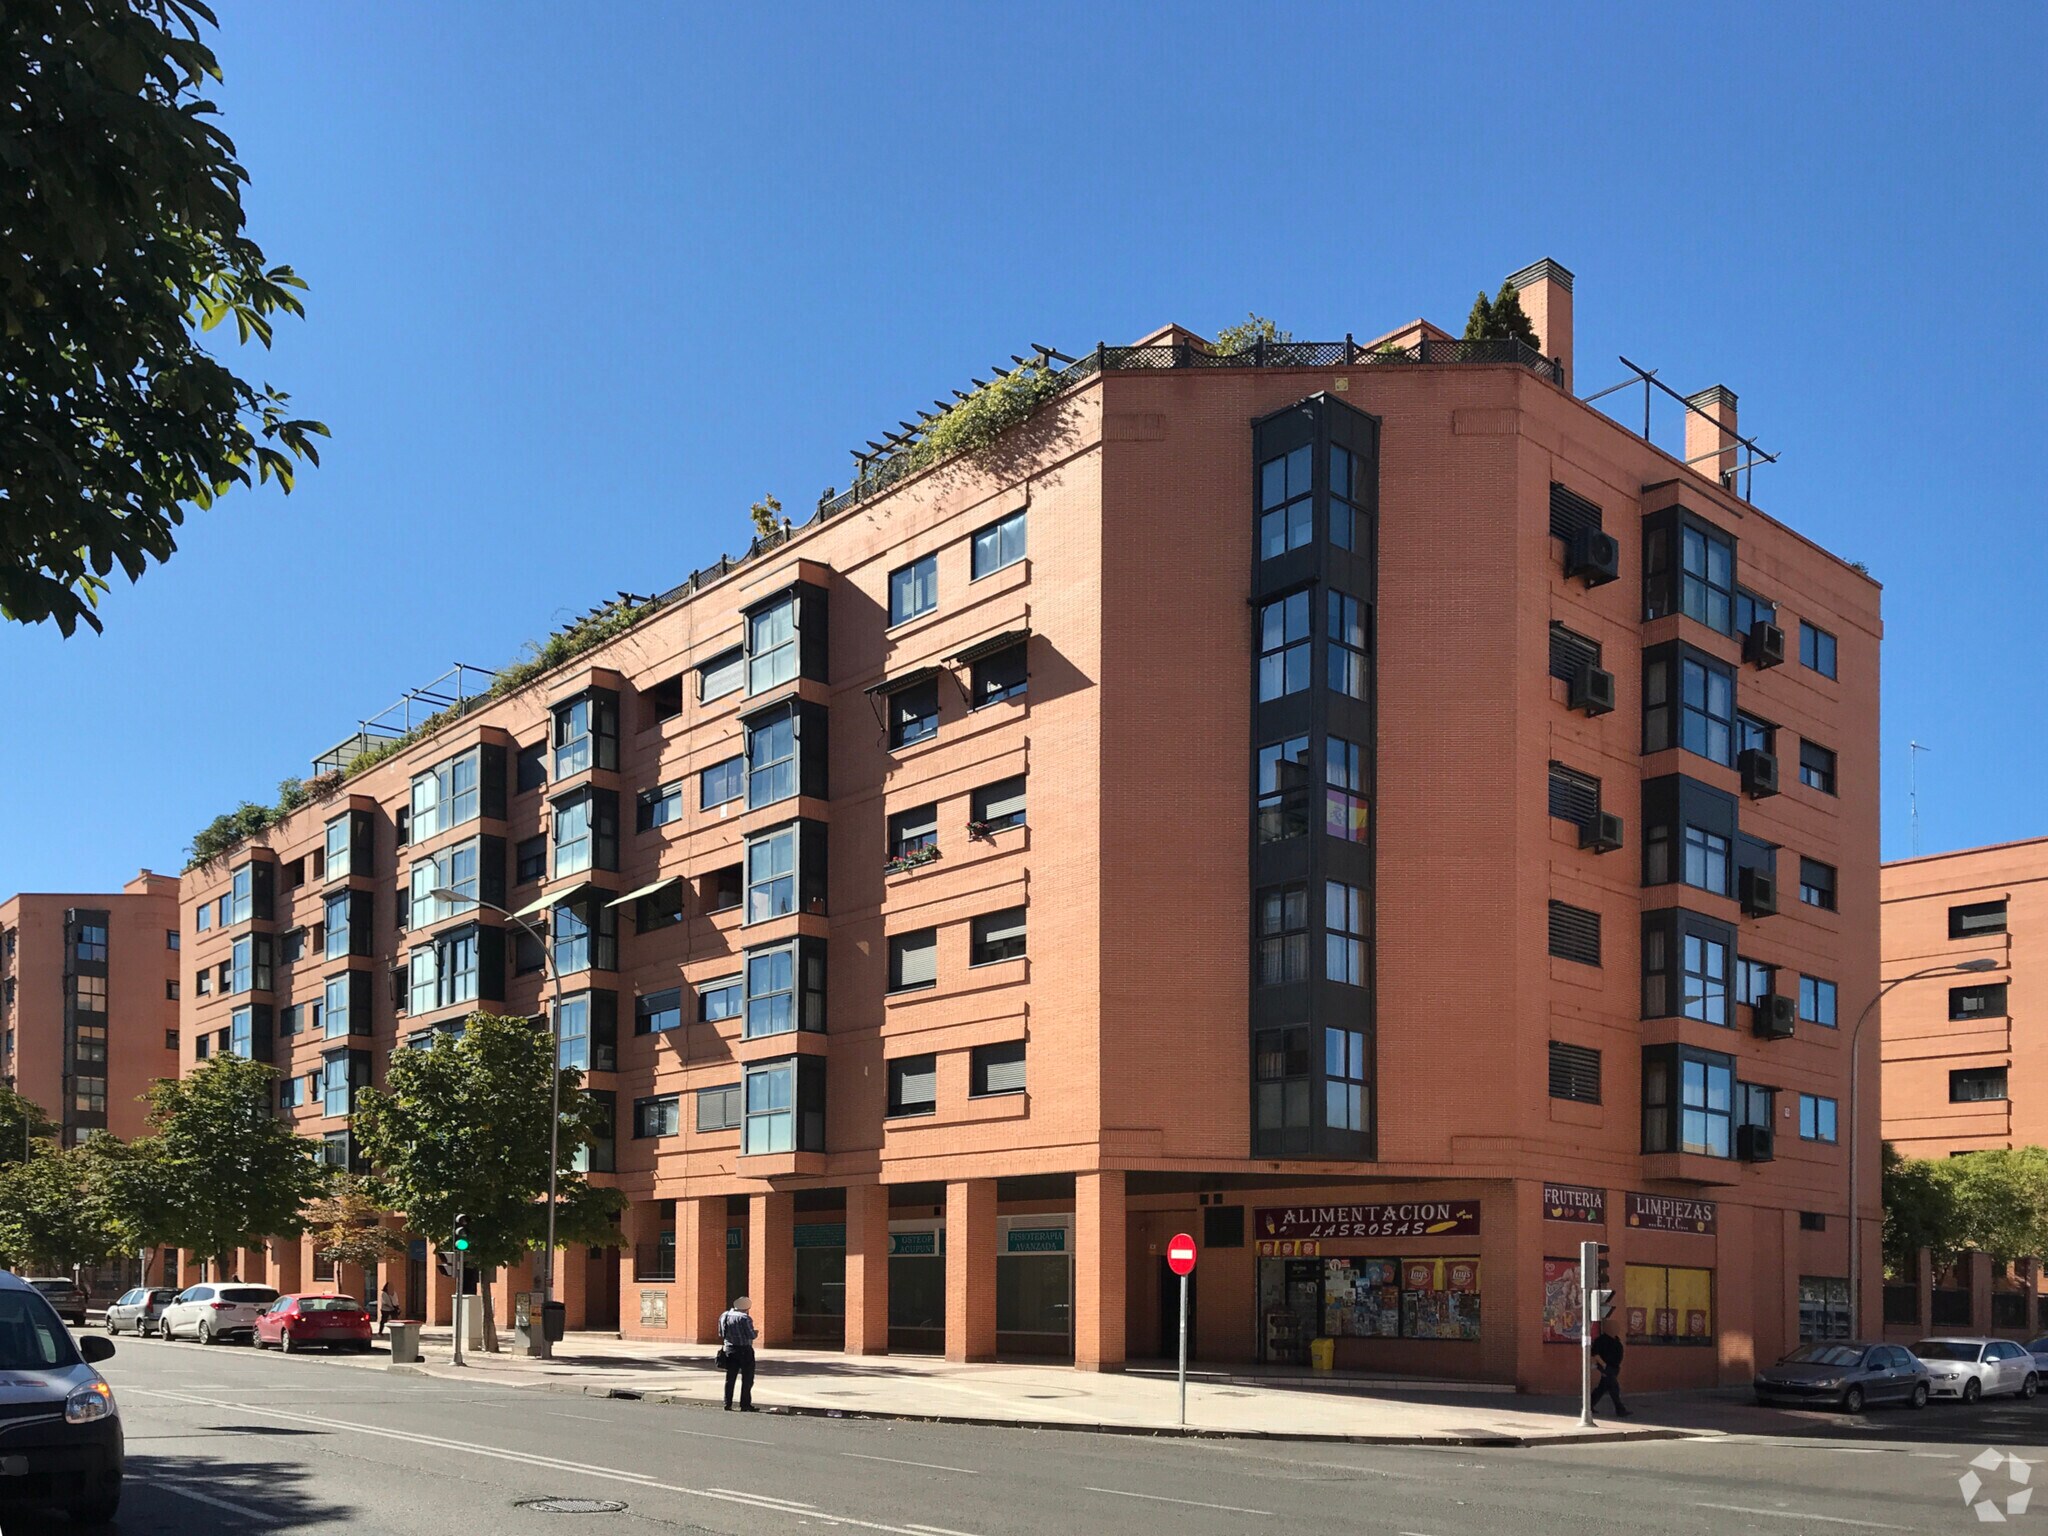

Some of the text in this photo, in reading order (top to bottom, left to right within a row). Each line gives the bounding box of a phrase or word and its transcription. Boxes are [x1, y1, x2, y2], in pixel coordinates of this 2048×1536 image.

[1544, 1188, 1603, 1208] FRUTERIA
[1283, 1204, 1450, 1224] ALIMENTACION
[1637, 1197, 1712, 1221] LIMPIEZAS
[1009, 1231, 1063, 1241] FISIOTERAPIA
[1014, 1242, 1057, 1251] AVANZADA
